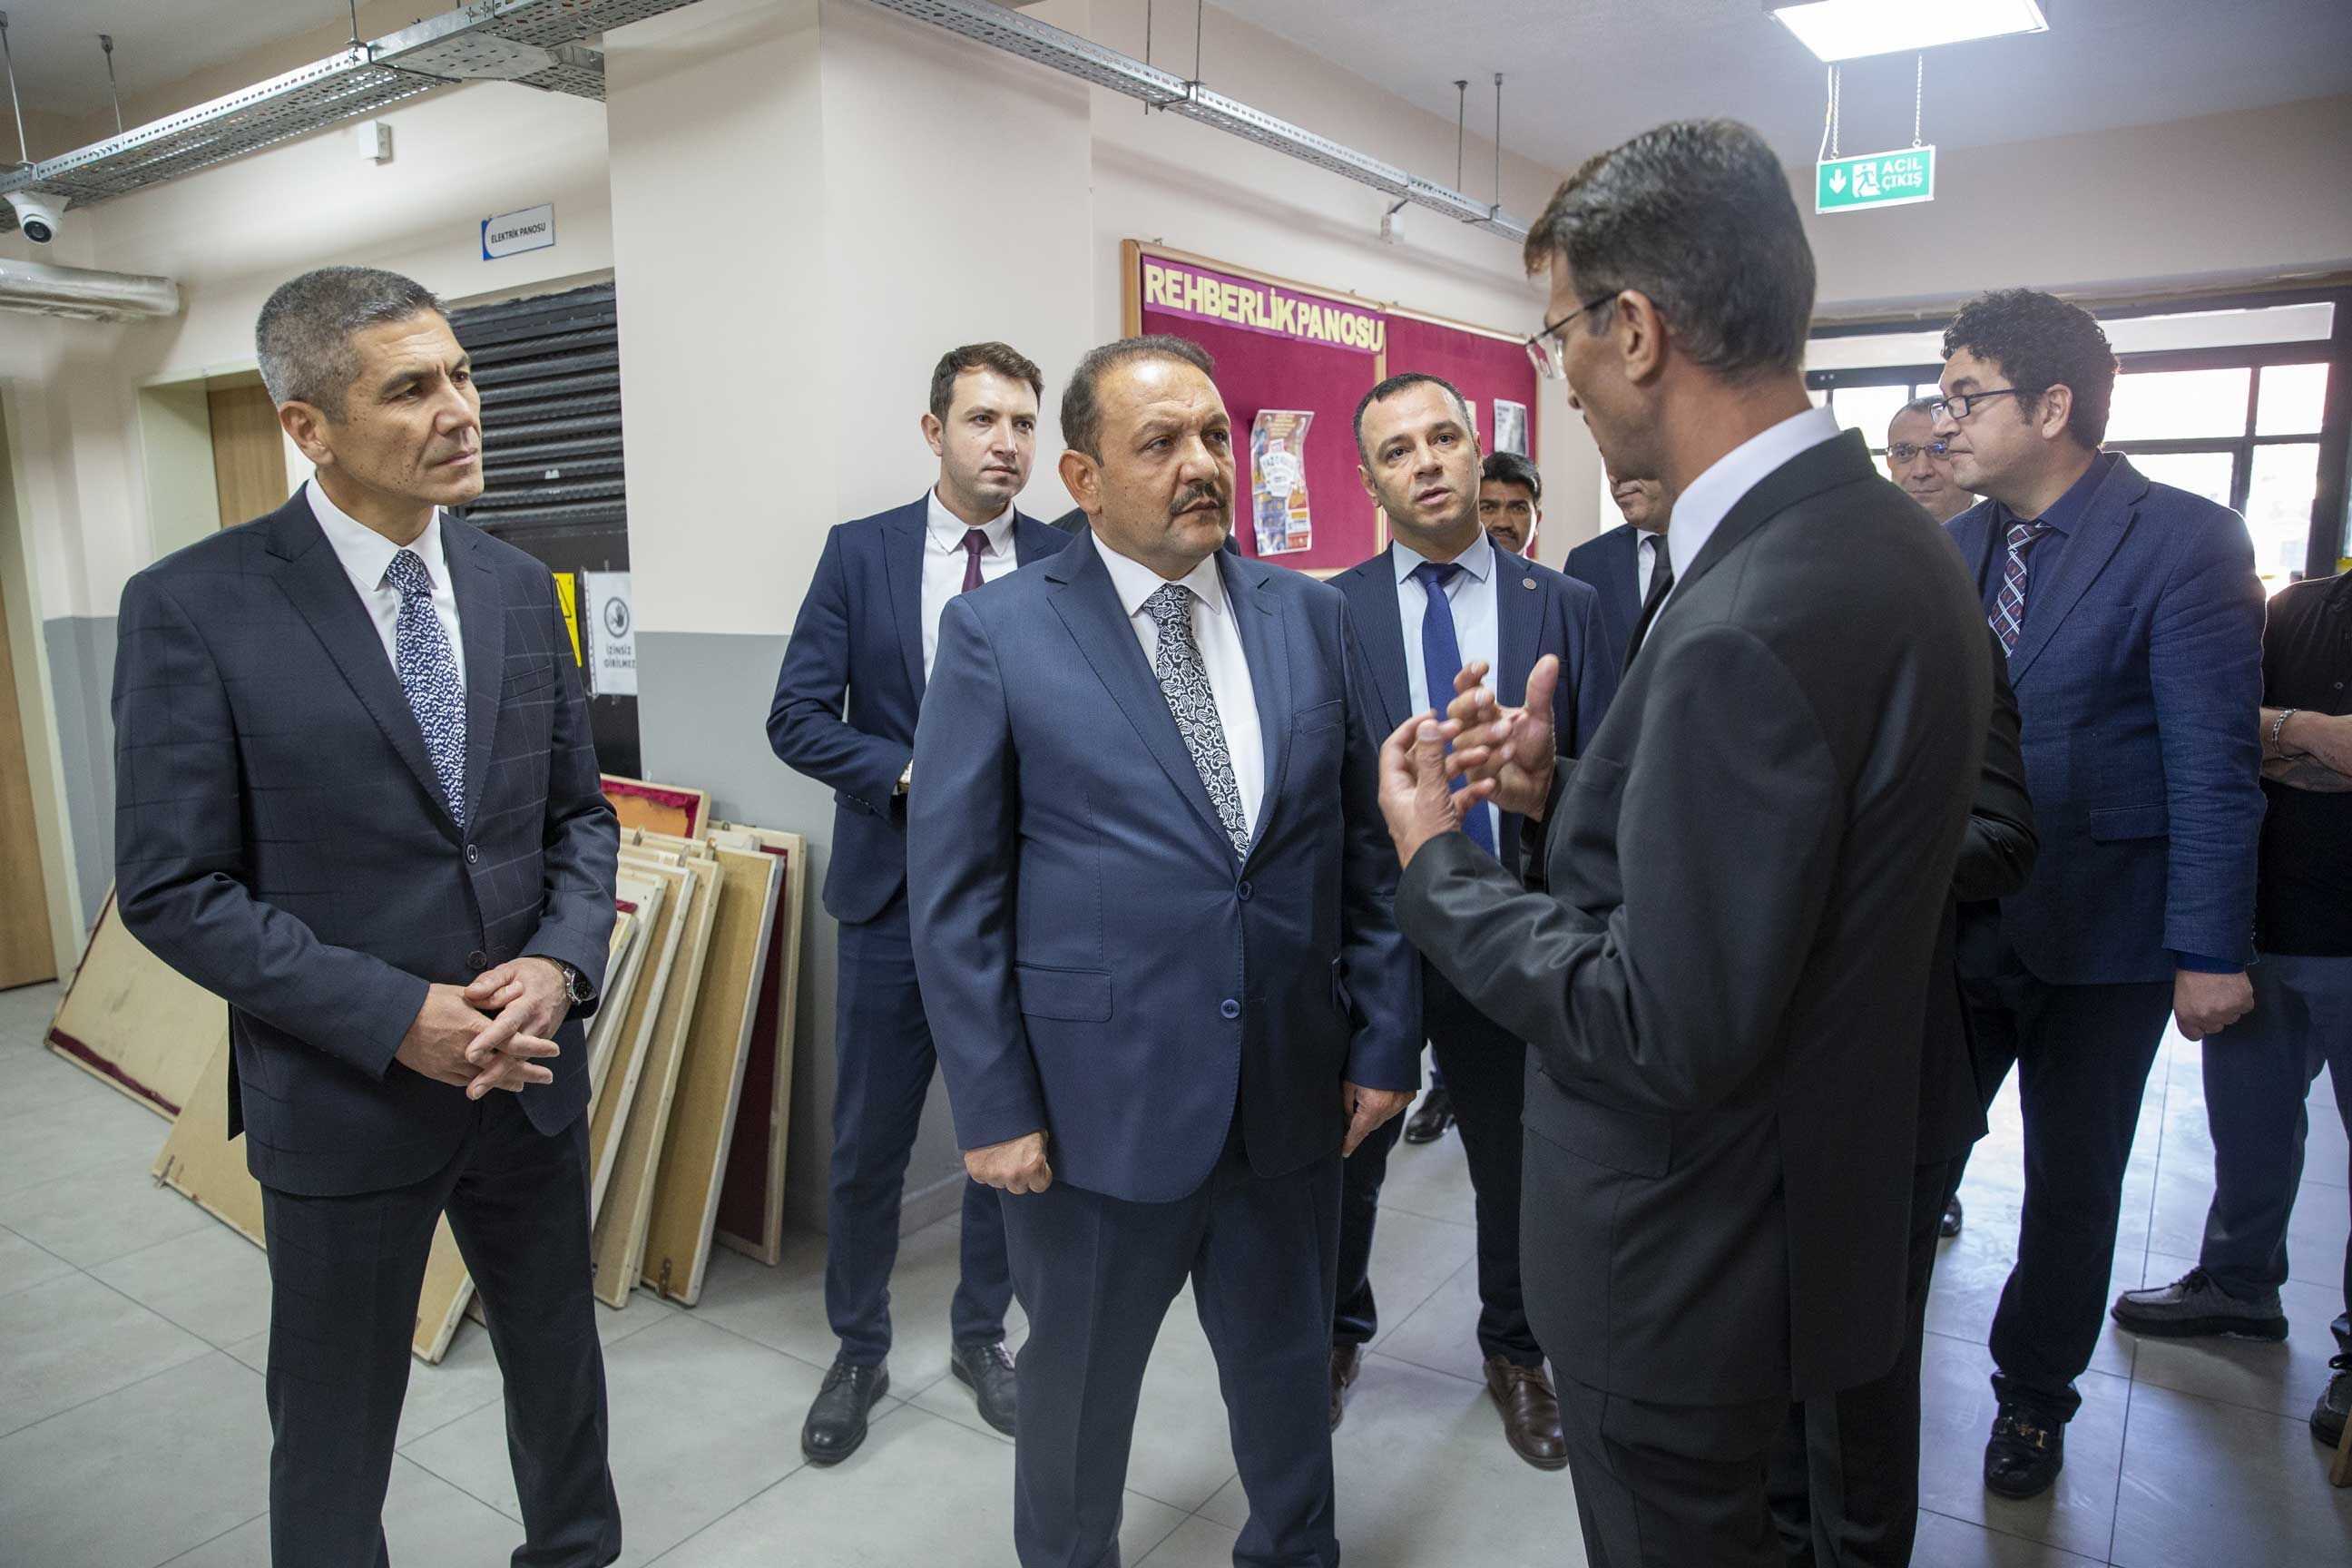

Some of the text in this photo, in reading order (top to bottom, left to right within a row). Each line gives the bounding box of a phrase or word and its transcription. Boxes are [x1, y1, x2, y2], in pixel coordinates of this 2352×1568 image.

[1882, 171, 1923, 191] ÇIKIŞ
[491, 222, 546, 244] ELEKTRİK PANOSU
